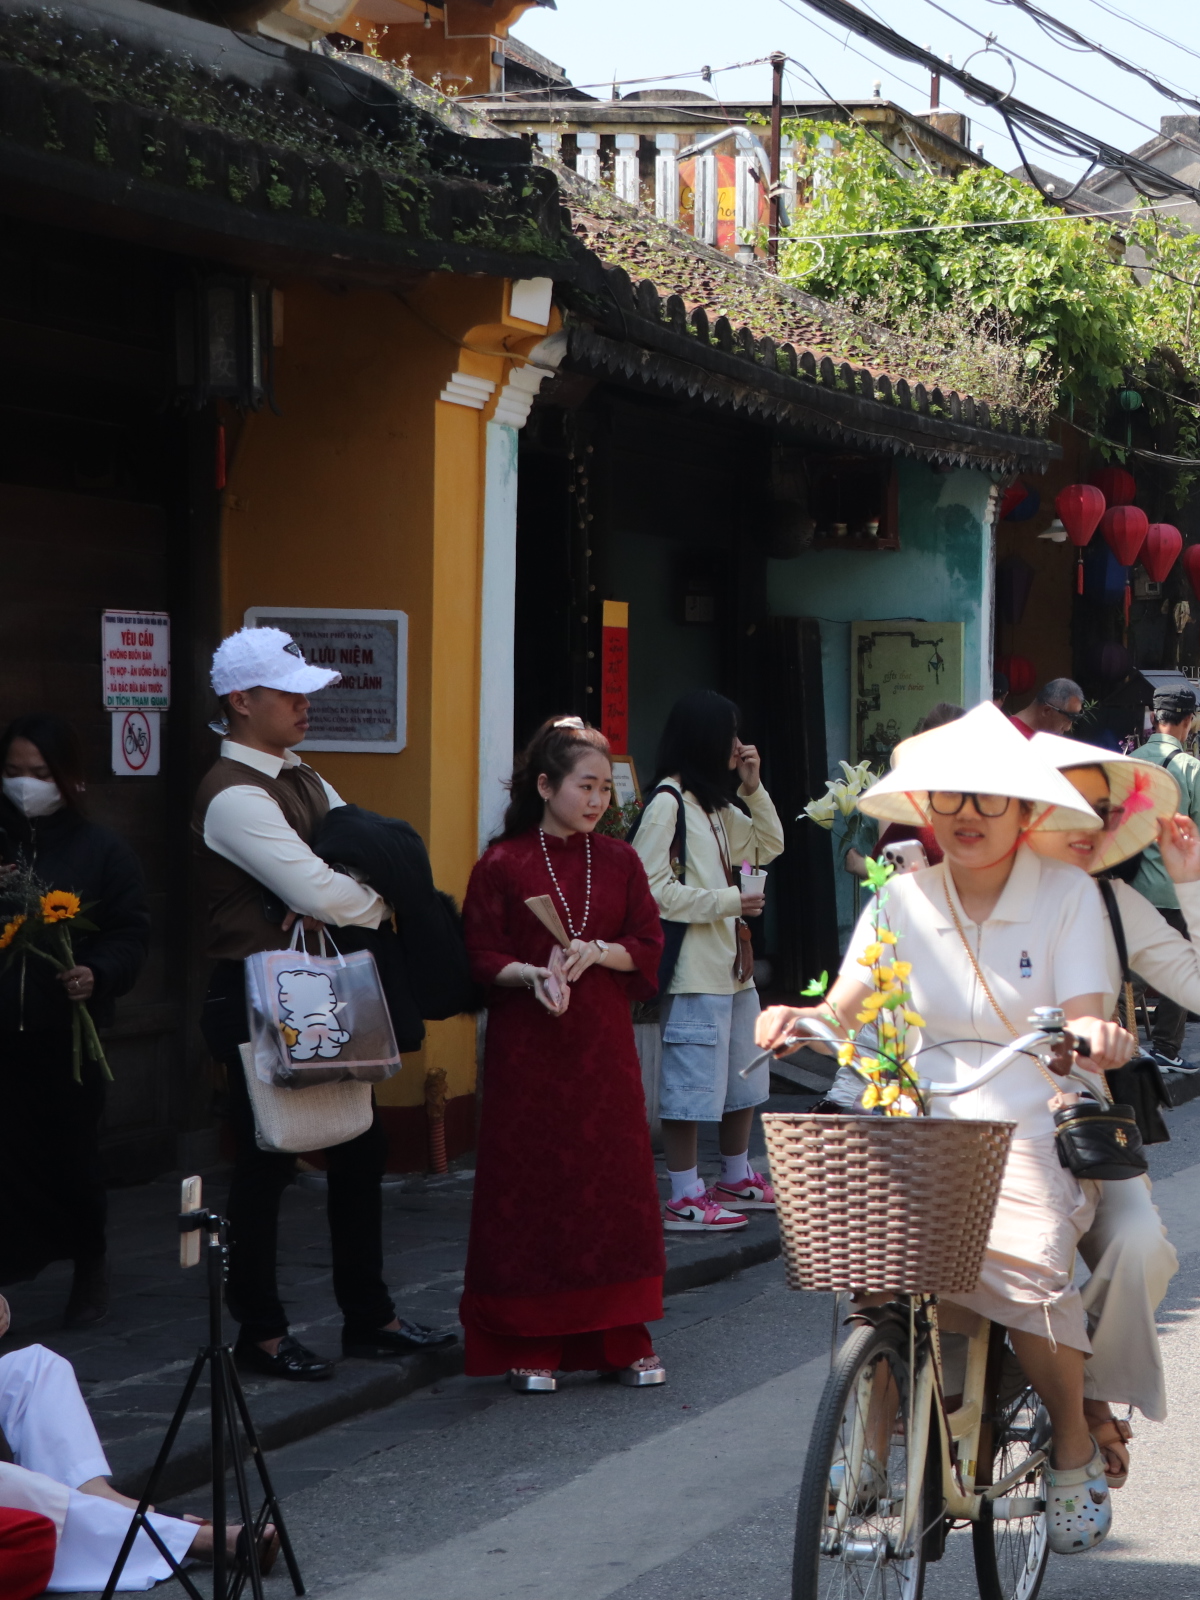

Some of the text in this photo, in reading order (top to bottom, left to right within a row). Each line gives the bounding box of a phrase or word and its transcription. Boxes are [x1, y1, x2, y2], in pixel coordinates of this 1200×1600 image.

[121, 629, 136, 646] YÊU
[363, 632, 374, 640] AN
[109, 648, 127, 659] KHÔNG
[310, 645, 336, 664] LƯU
[340, 644, 374, 667] NIỆM
[356, 672, 382, 690] LÃNH
[882, 669, 897, 684] gifts
[892, 683, 925, 695] give twice
[107, 693, 168, 706] DI TÍCH THAM QUAN
